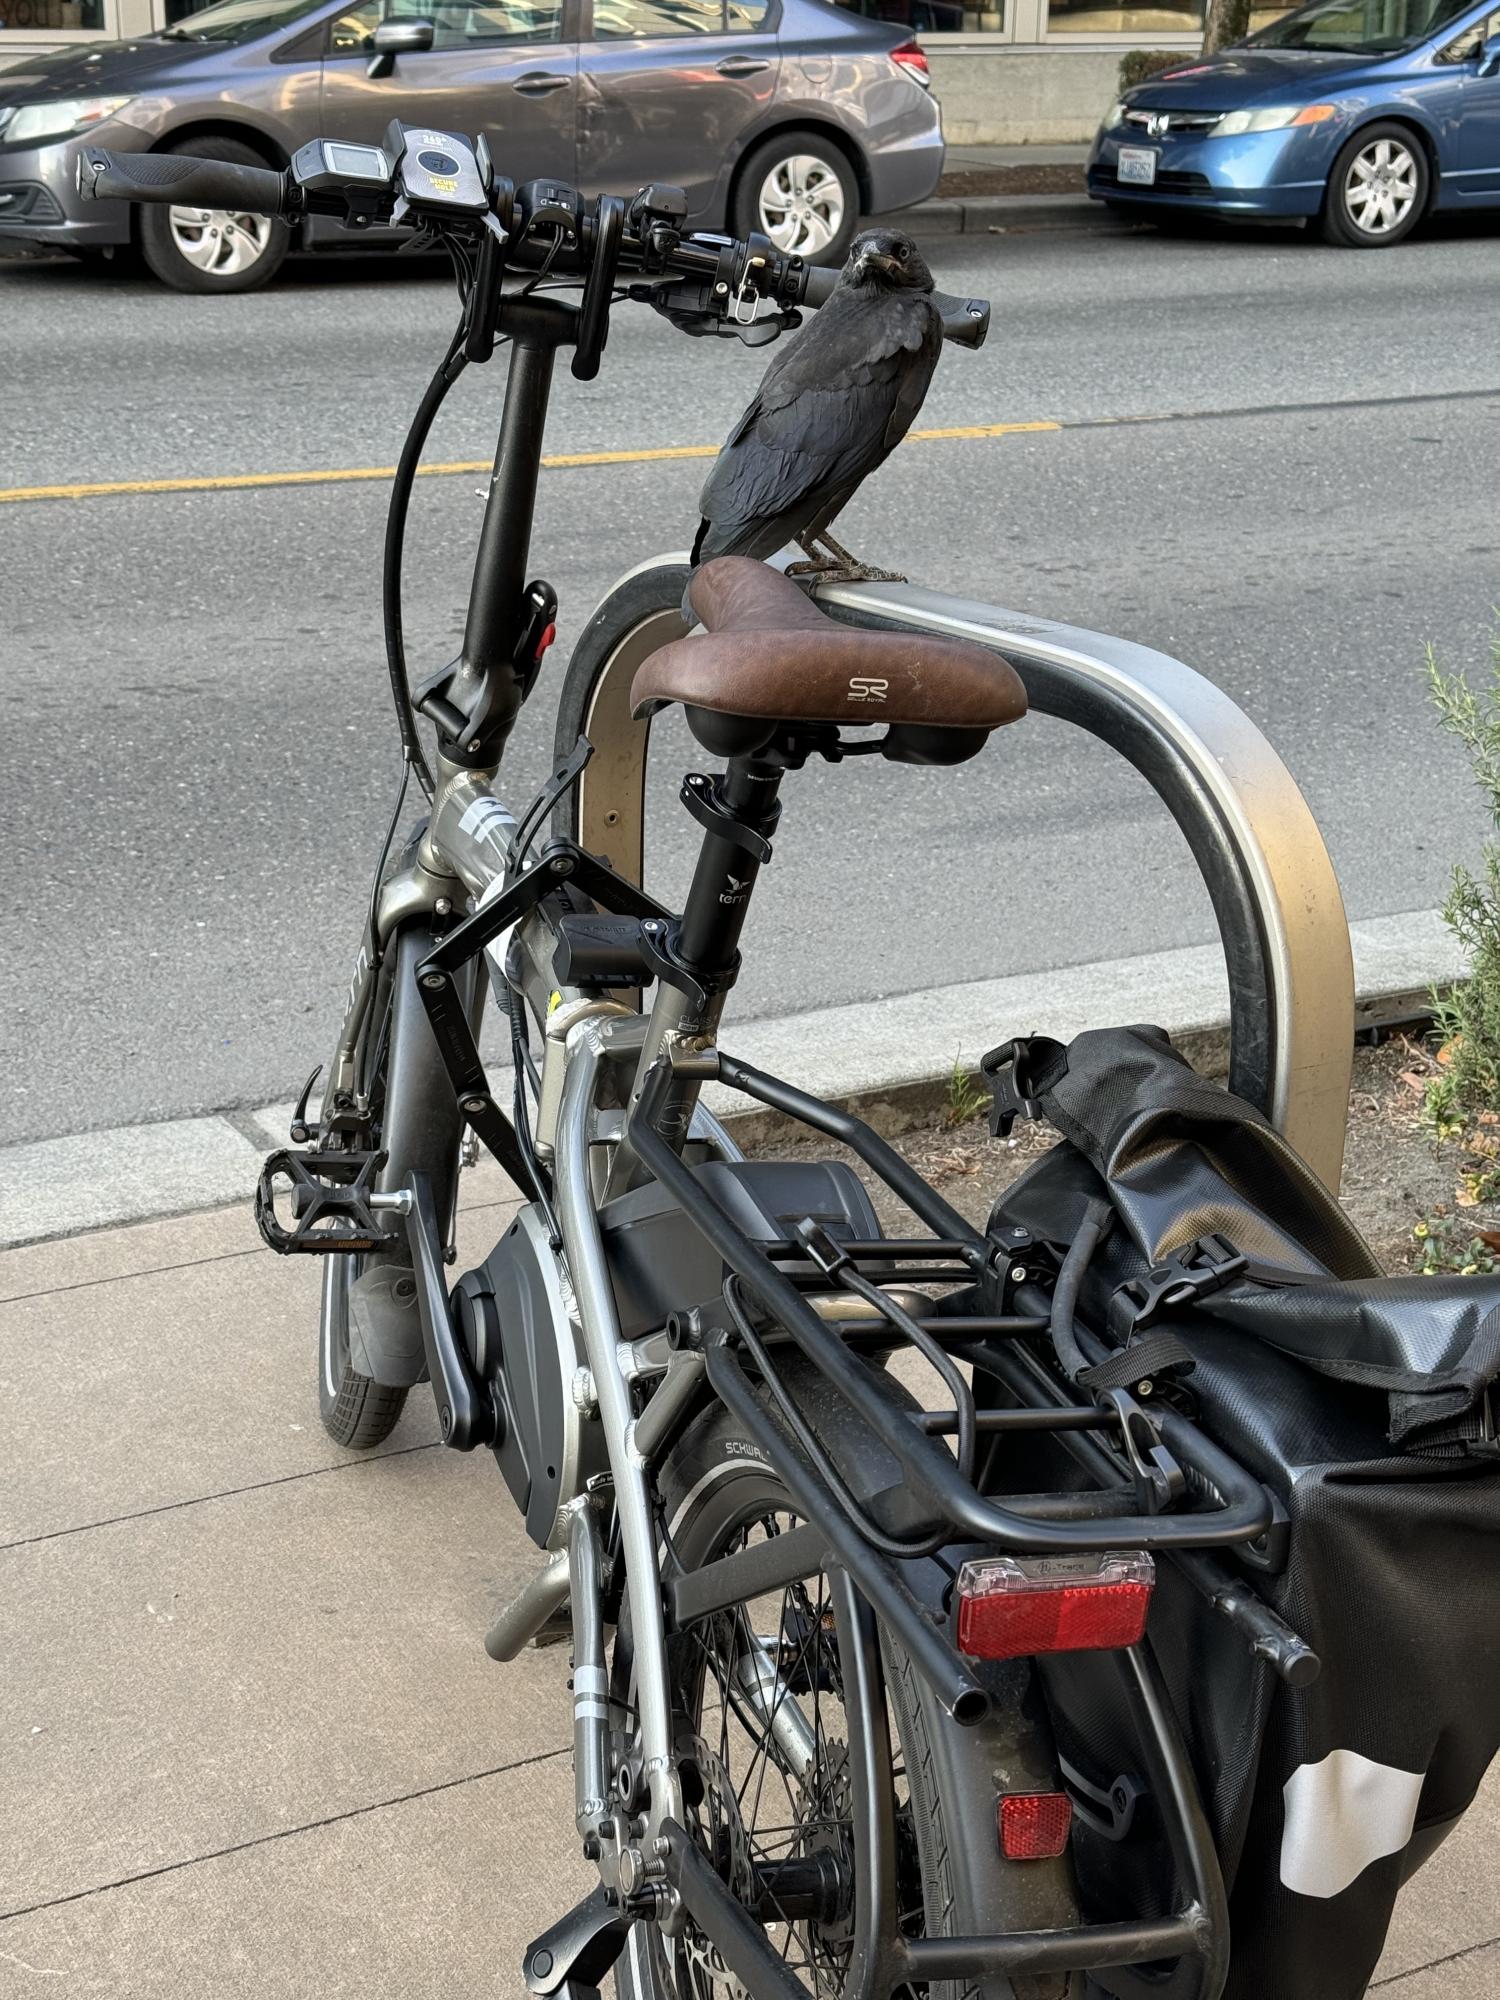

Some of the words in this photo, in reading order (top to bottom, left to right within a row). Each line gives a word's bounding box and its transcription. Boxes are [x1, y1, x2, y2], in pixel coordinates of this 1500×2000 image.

[847, 677, 889, 699] SR
[719, 893, 747, 904] tern
[725, 1441, 770, 1462] SCHWAL
